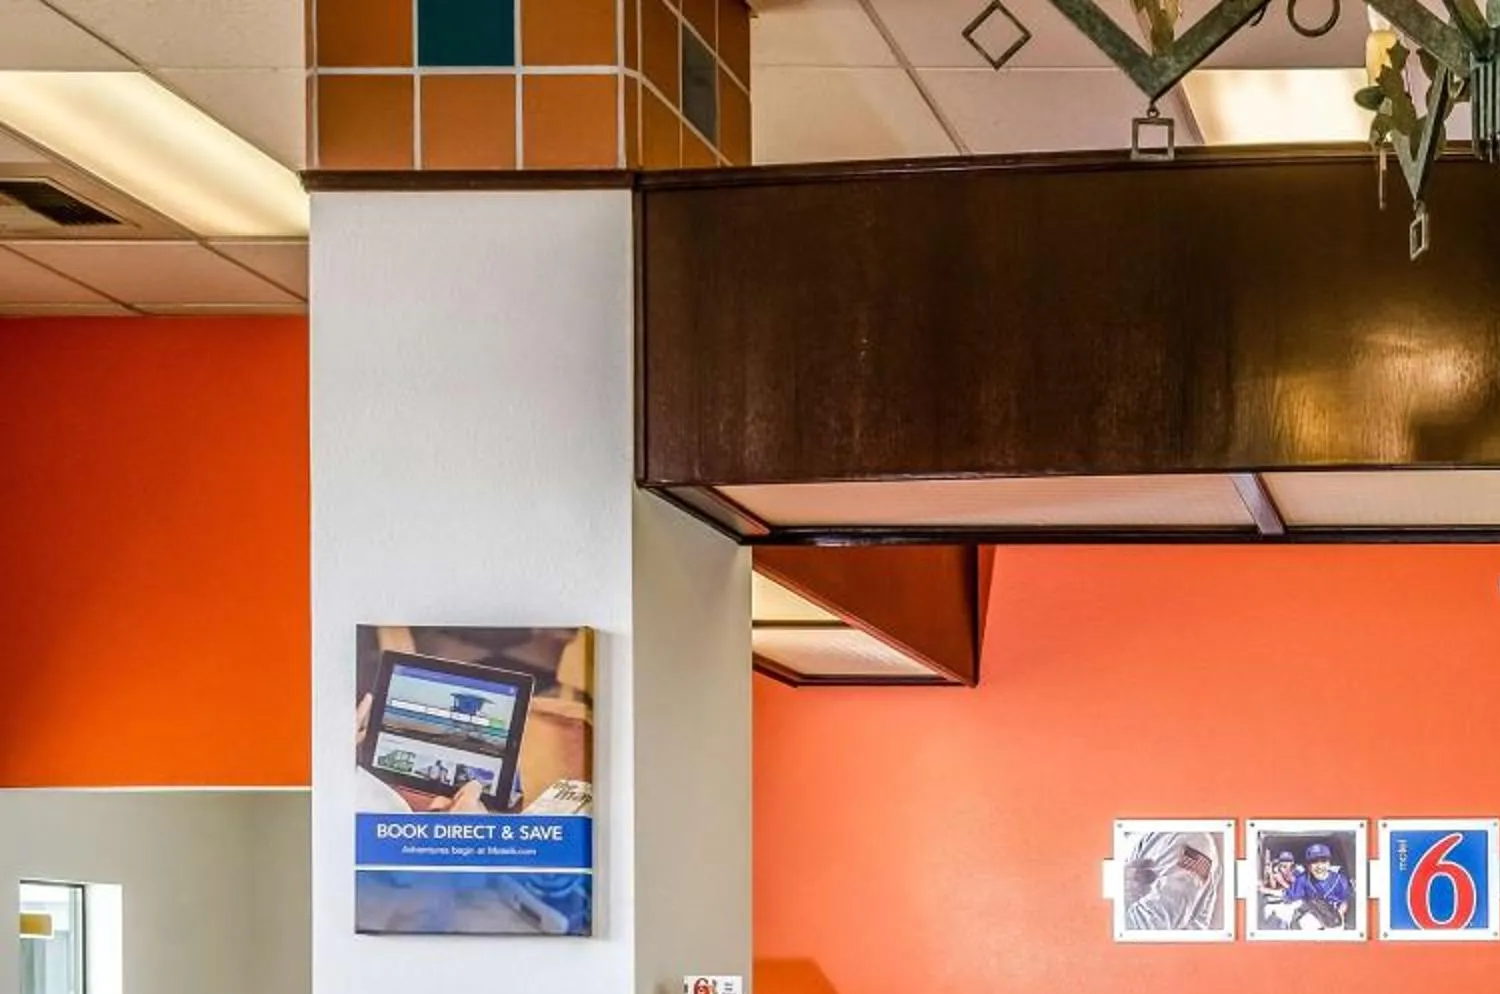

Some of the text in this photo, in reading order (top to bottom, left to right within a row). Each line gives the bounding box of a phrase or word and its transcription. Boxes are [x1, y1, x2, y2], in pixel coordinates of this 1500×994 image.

[376, 823, 563, 841] BOOK DIRECT & SAVE
[1407, 832, 1477, 930] 6
